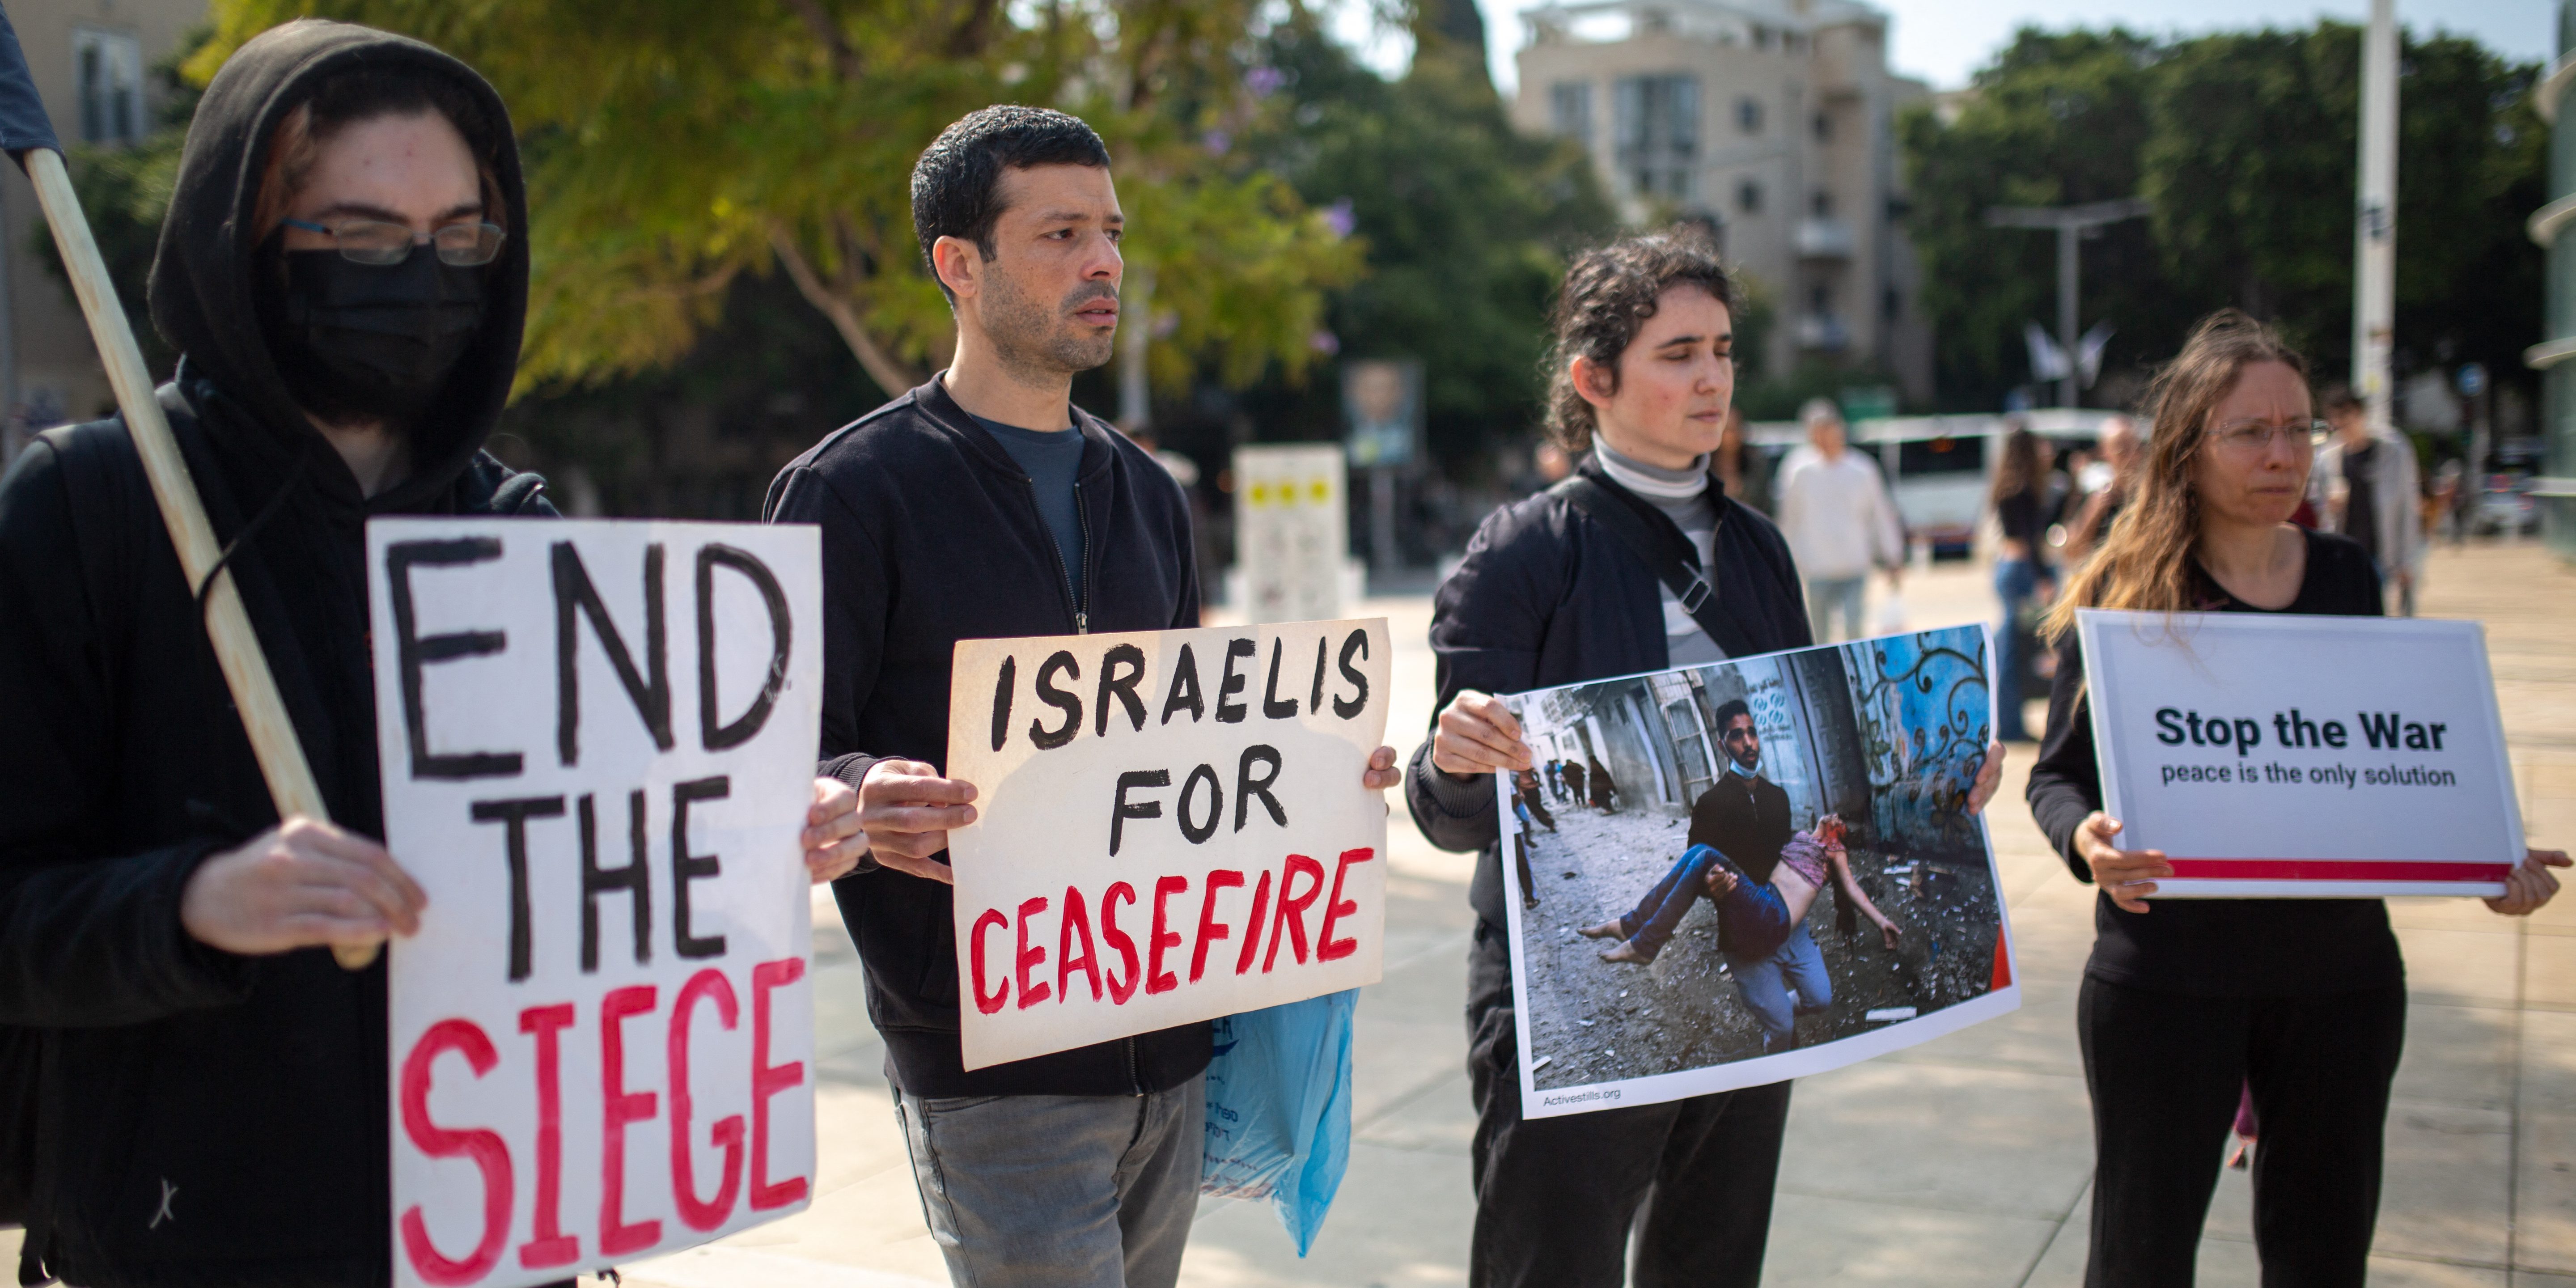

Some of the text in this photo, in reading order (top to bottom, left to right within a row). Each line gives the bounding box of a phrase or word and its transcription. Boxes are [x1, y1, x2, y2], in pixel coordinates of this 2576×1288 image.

[386, 537, 791, 780] END
[991, 629, 1369, 752] ISRAELIS
[2155, 708, 2447, 757] Stop the War
[2161, 763, 2456, 789] peace is the only solution
[1109, 744, 1288, 857] FOR
[470, 776, 730, 983] THE
[970, 847, 1375, 1016] CEASEFIRE
[399, 957, 808, 1287] SIEGE
[1543, 1089, 1621, 1107] Activestills.org
